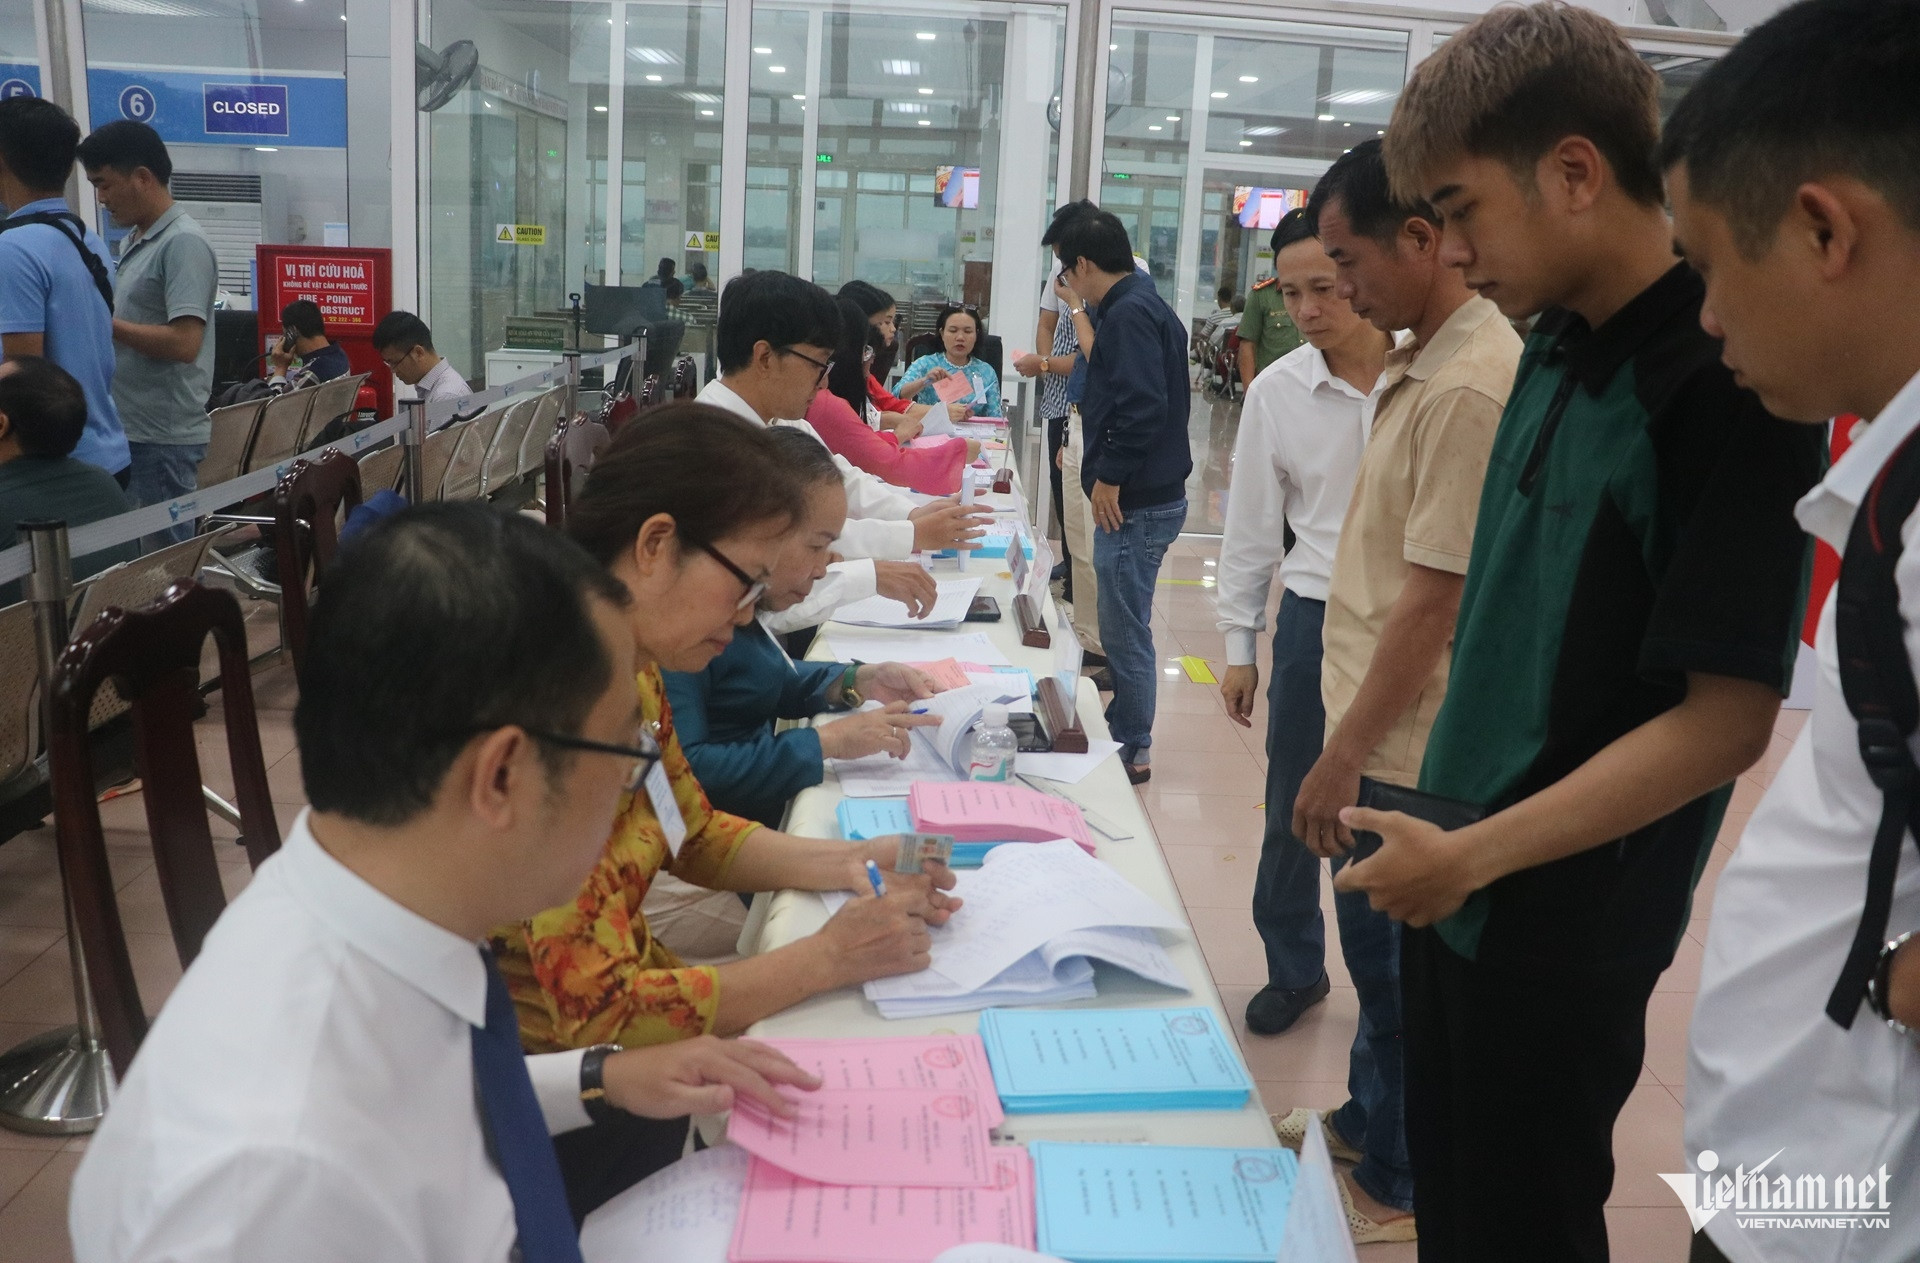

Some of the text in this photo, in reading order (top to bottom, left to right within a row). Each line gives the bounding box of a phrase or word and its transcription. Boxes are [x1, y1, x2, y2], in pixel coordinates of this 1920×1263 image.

[129, 93, 145, 117] 6
[212, 100, 280, 116] CLOSED
[516, 227, 543, 236] CAUTION
[285, 262, 365, 279] VỊ TRÍ CỨU HOẢ
[326, 295, 353, 304] POINT
[320, 306, 365, 316] OBSTRUCT
